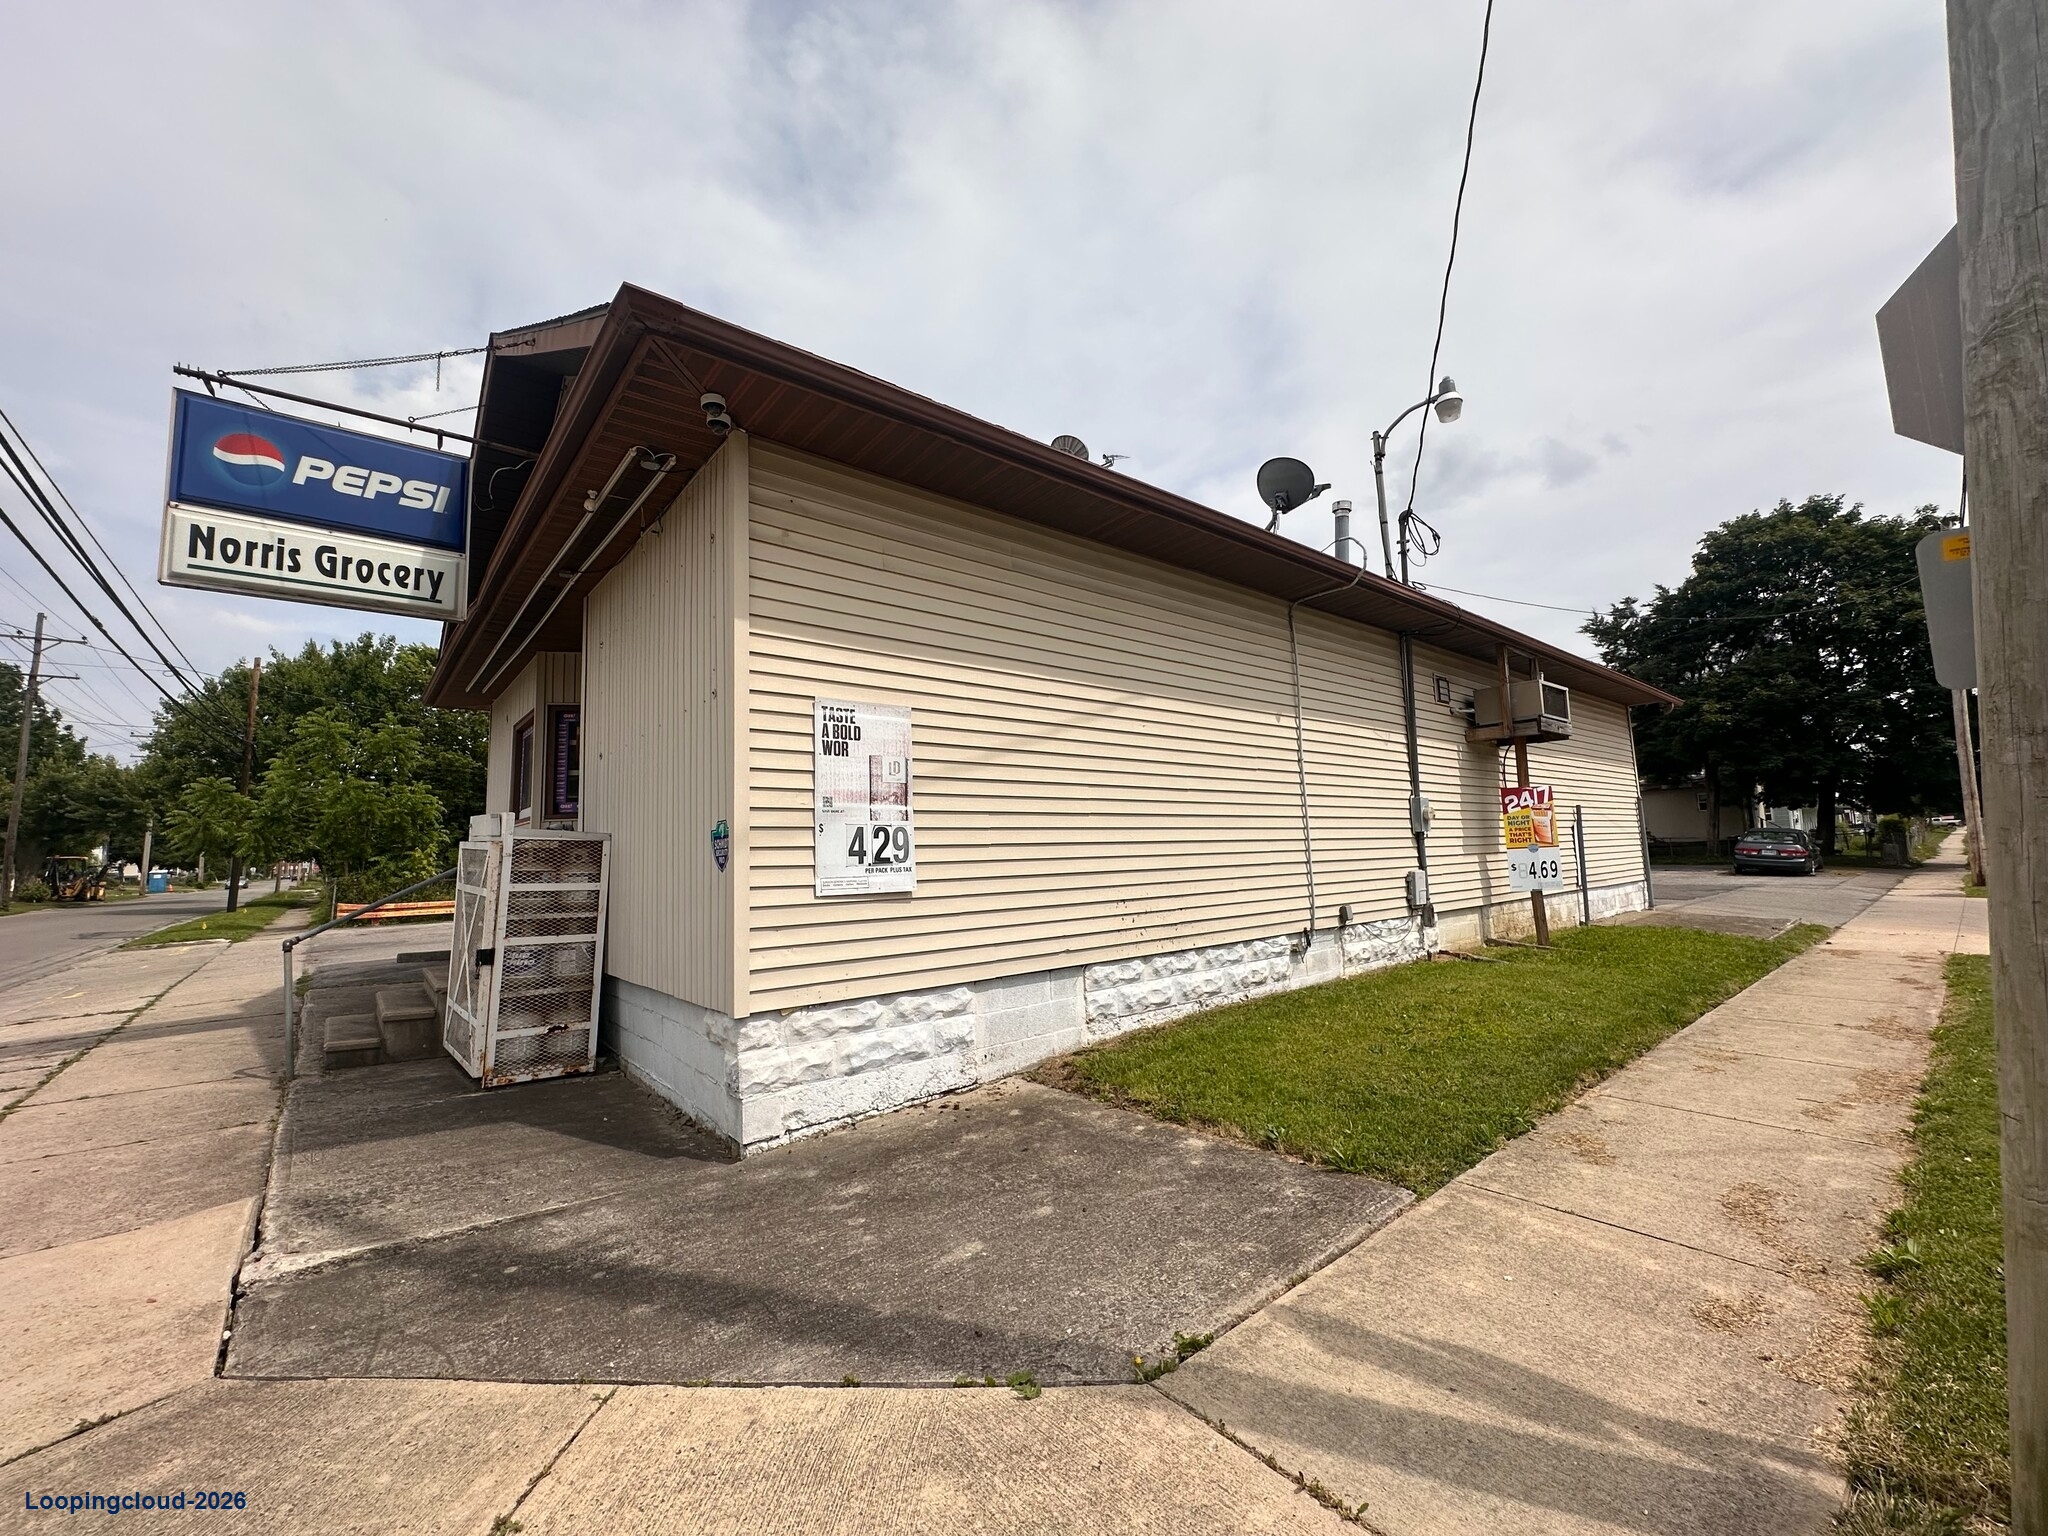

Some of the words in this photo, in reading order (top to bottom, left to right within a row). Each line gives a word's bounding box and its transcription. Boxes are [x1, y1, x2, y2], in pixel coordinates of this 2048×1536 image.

[292, 455, 451, 514] PEPSI
[187, 523, 301, 573] Norris
[314, 545, 445, 601] Grocery
[821, 705, 856, 724] TASTE
[821, 723, 830, 739] A
[832, 723, 862, 741] BOLD
[822, 739, 849, 757] WOR
[847, 825, 910, 867] 4.29
[875, 866, 889, 874] PACK
[890, 866, 902, 874] PLUS
[1510, 863, 1517, 872] $
[1529, 860, 1558, 880] 4.69
